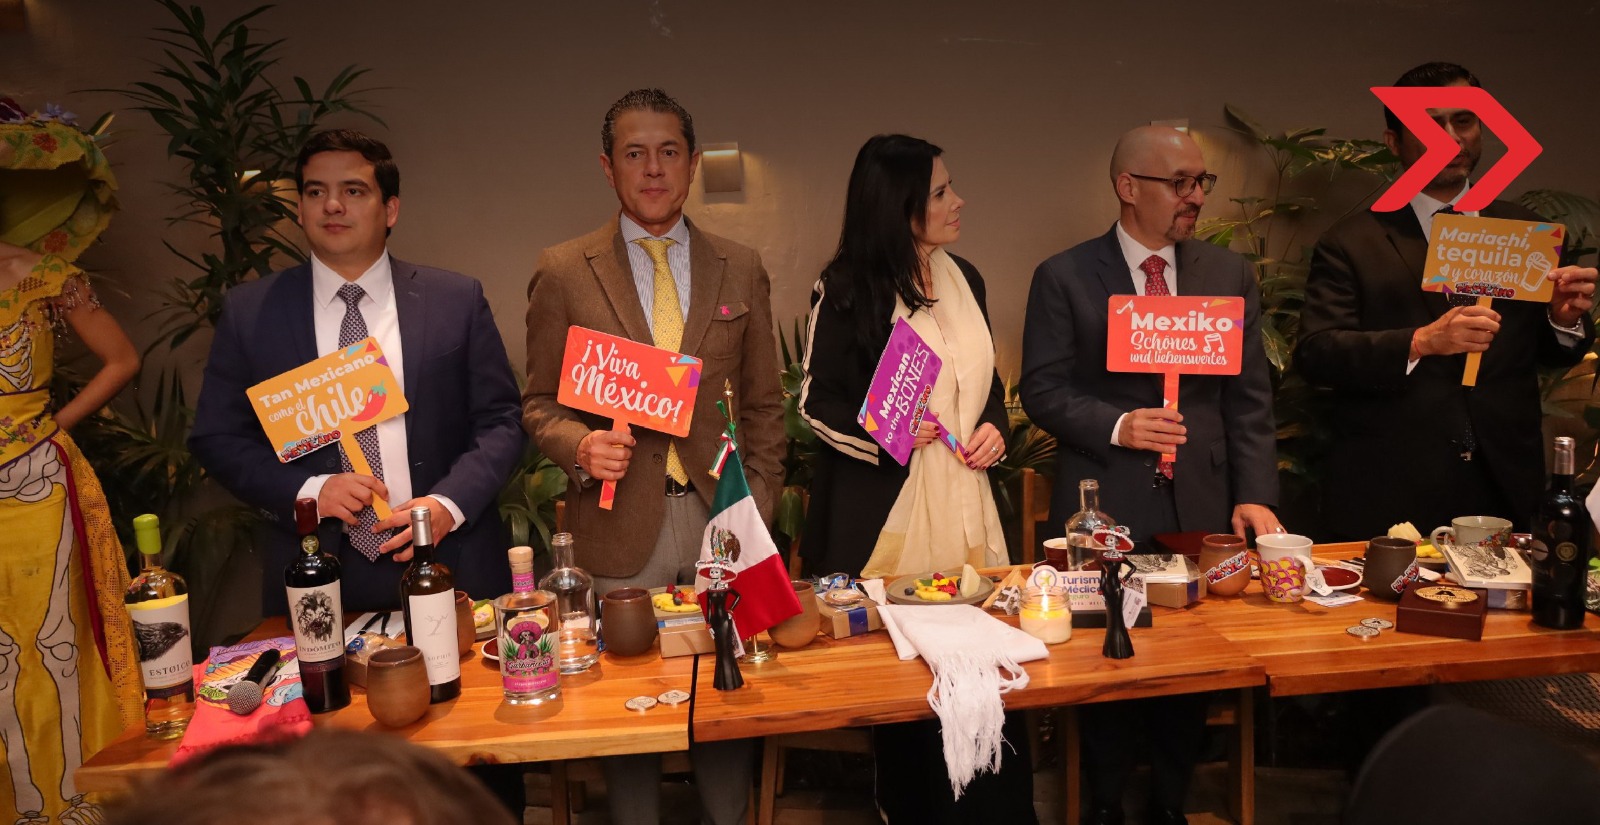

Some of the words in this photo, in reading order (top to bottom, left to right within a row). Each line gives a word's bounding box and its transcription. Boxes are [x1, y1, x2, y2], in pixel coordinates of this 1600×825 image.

[1439, 227, 1530, 249] Mariachi,
[1437, 244, 1522, 267] tequila
[1451, 268, 1461, 282] y
[1464, 266, 1520, 285] corazón
[1131, 310, 1233, 332] Mexiko
[1131, 331, 1197, 353] Schönes
[581, 340, 640, 380] ¡Viva
[1130, 350, 1152, 364] und
[1154, 350, 1228, 365] liebenswertes
[259, 388, 293, 408] Tan
[294, 354, 375, 394] Mexicano
[879, 353, 910, 419] Mexican
[895, 343, 930, 416] BONES
[571, 363, 683, 423] México!
[269, 407, 294, 423] como
[295, 398, 306, 412] el
[890, 412, 901, 430] the
[885, 433, 894, 444] to
[1061, 576, 1101, 584] Turism
